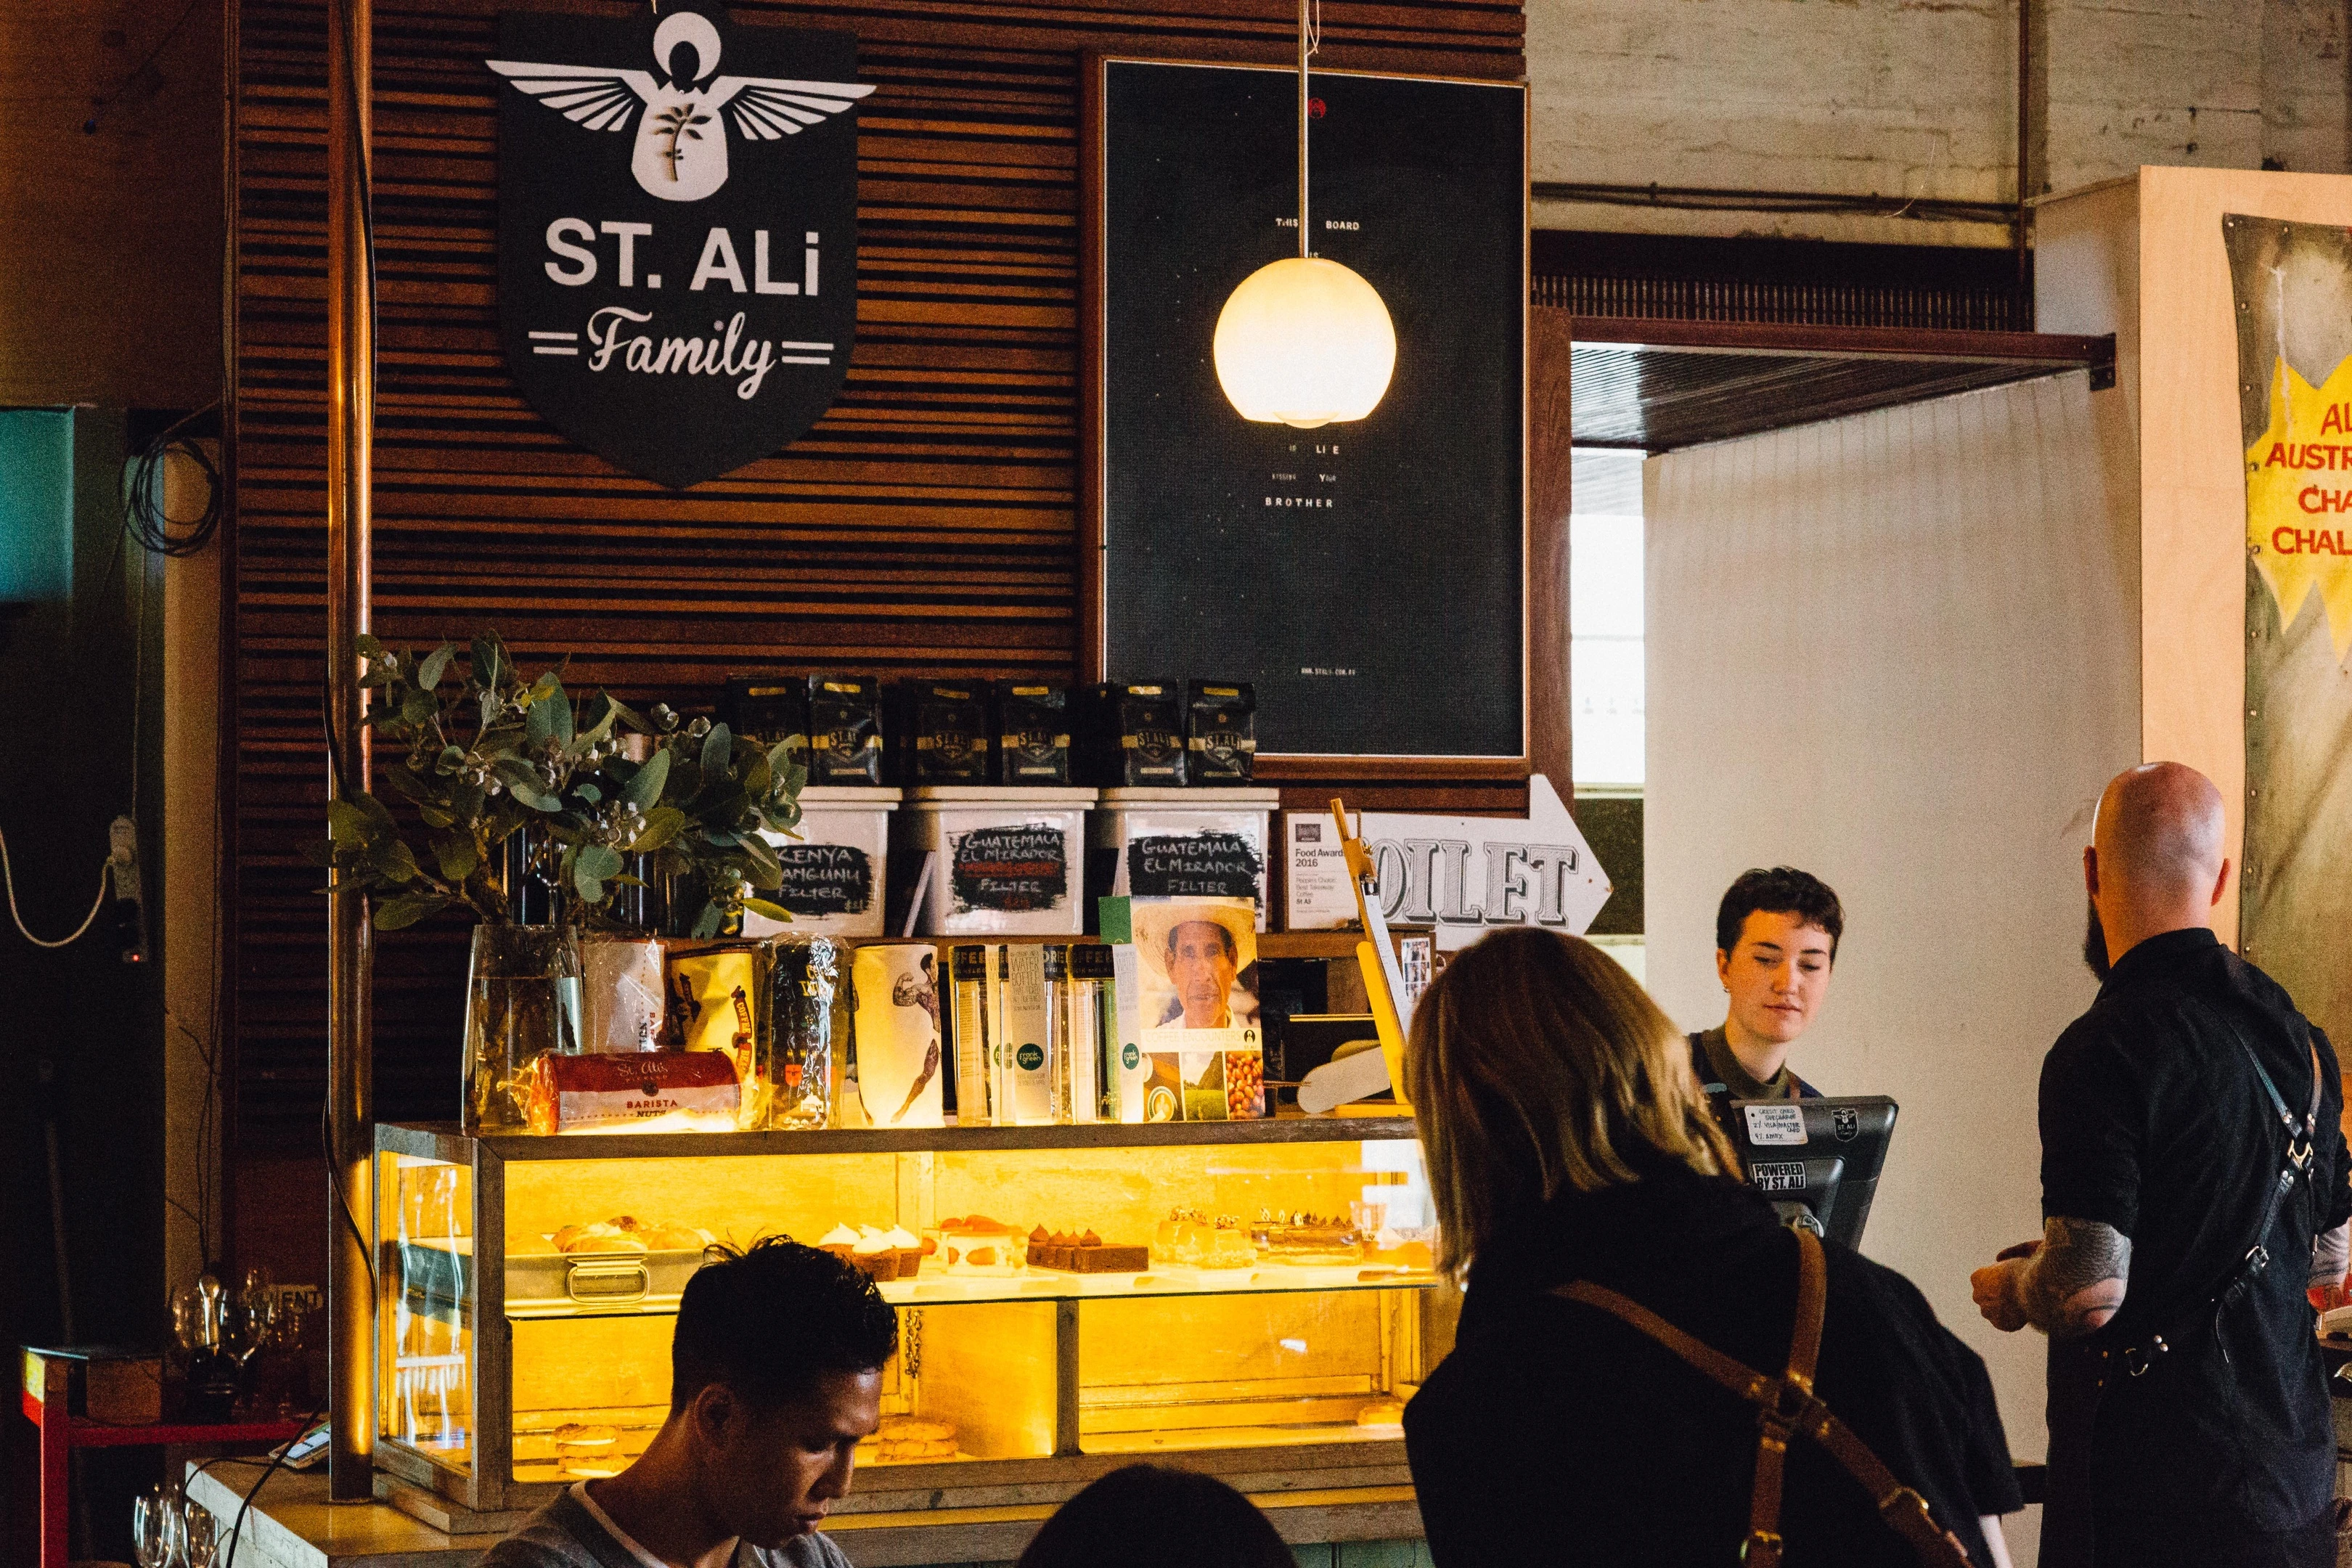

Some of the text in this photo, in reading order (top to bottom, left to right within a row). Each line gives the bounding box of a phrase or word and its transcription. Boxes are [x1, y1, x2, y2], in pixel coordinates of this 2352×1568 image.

[1326, 221, 1360, 231] BOARD
[544, 218, 661, 288] ST.
[587, 306, 776, 399] Family
[1265, 497, 1333, 508] BROTHER
[1142, 838, 1241, 857] GUATEMALA
[1296, 848, 1344, 857] Food Award
[1296, 858, 1318, 867] 2016
[1371, 838, 1580, 929] OILET
[626, 1099, 678, 1109] BARISTA
[1755, 1164, 1804, 1177] POWERED
[1757, 1177, 1769, 1190] BY
[1772, 1176, 1787, 1190] ST.
